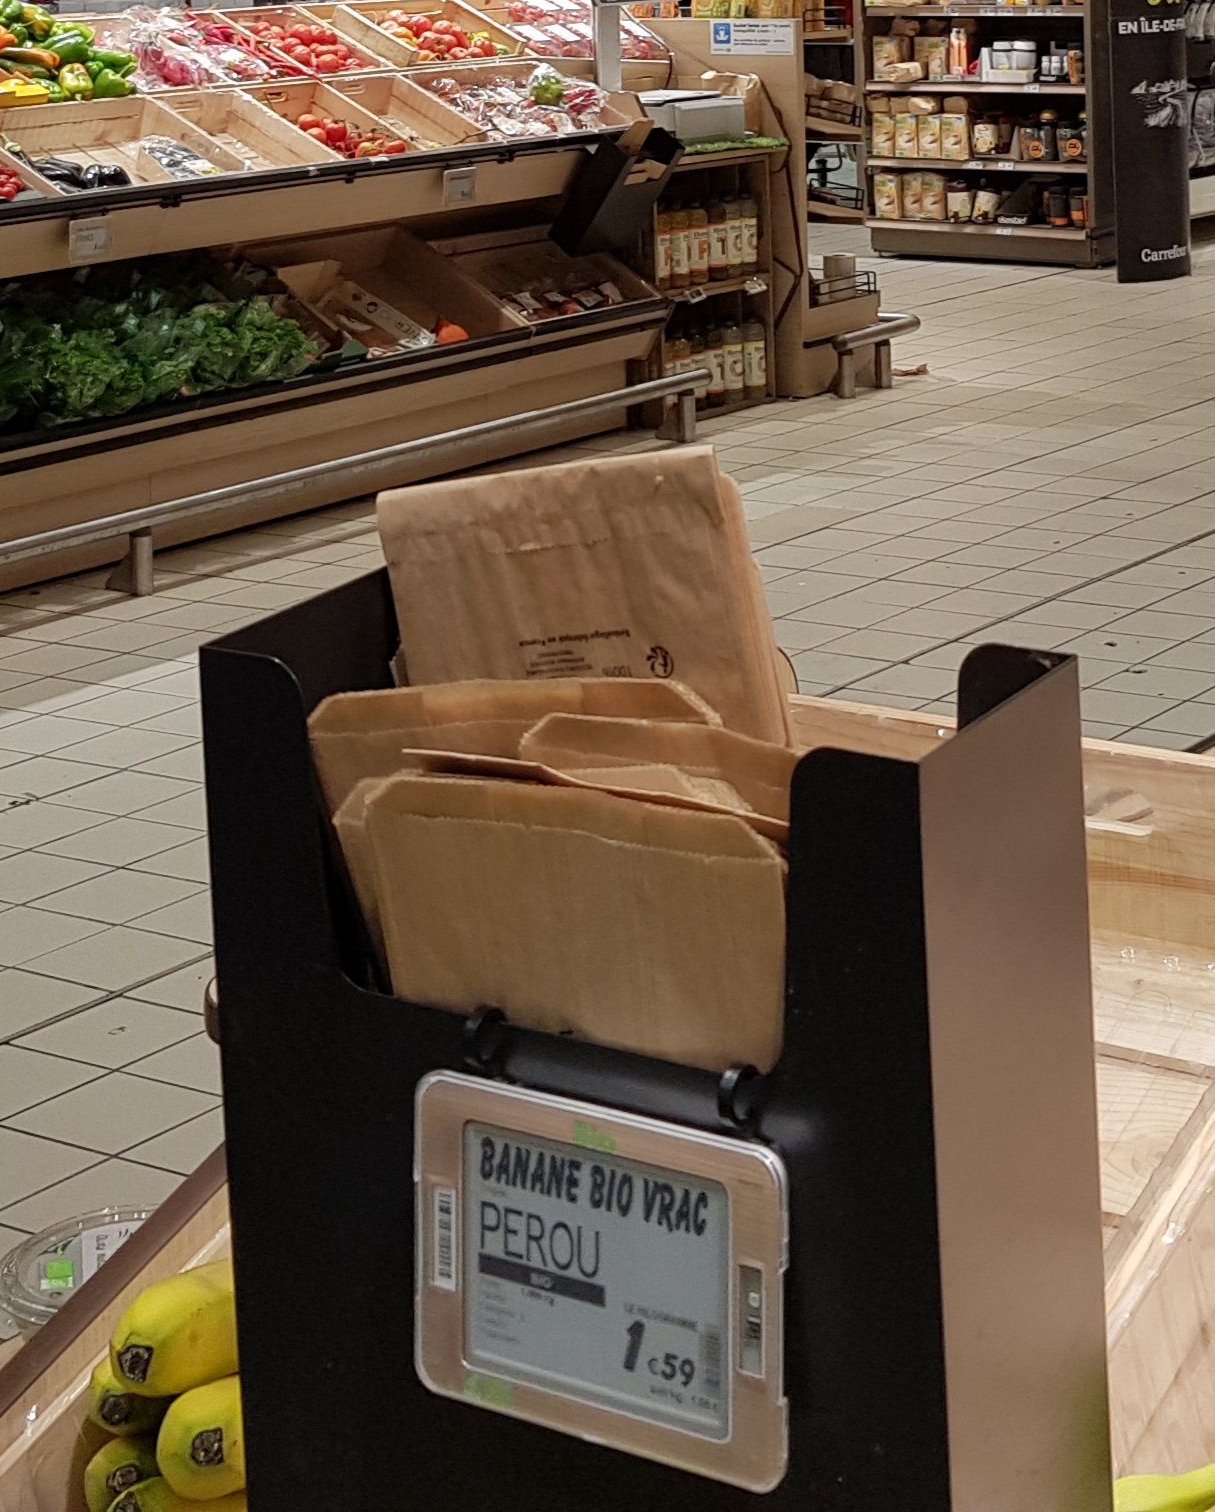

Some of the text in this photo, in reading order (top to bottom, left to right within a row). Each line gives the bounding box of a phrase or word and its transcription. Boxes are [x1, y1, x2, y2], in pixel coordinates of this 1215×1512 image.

[1118, 22, 1138, 35] EN
[480, 1136, 708, 1236] BANANE BIO VRAC
[480, 1200, 600, 1278] PEROU
